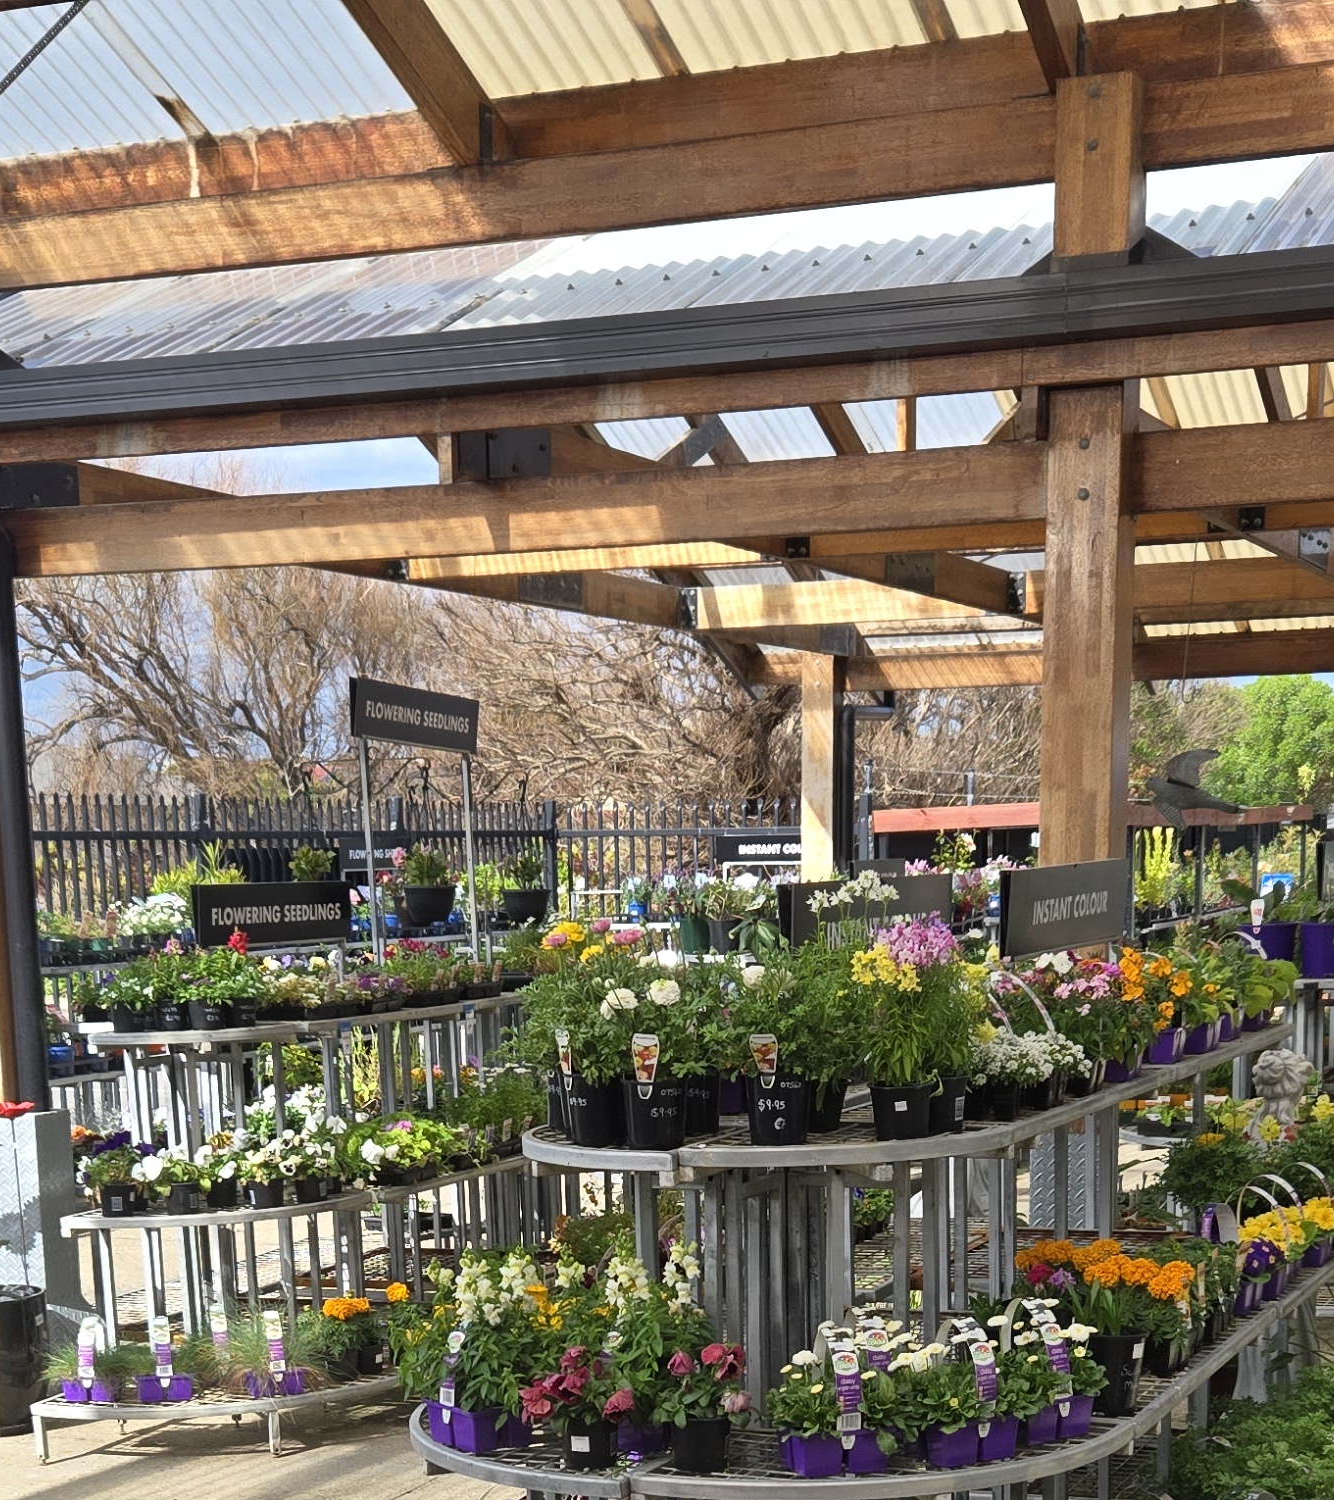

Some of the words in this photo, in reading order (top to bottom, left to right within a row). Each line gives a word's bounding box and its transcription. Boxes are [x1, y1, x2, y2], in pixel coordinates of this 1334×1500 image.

[366, 700, 421, 726] FLOWERING
[423, 711, 470, 733] SEEDLINGS
[349, 848, 384, 859] FLOWNG
[738, 843, 782, 855] INSTANT
[211, 905, 281, 926] FLOWERING
[284, 903, 342, 922] SEEDLINGS
[1033, 896, 1072, 925] INSTANT
[1074, 891, 1108, 918] COLOUR
[758, 1099, 786, 1112] $9.95
